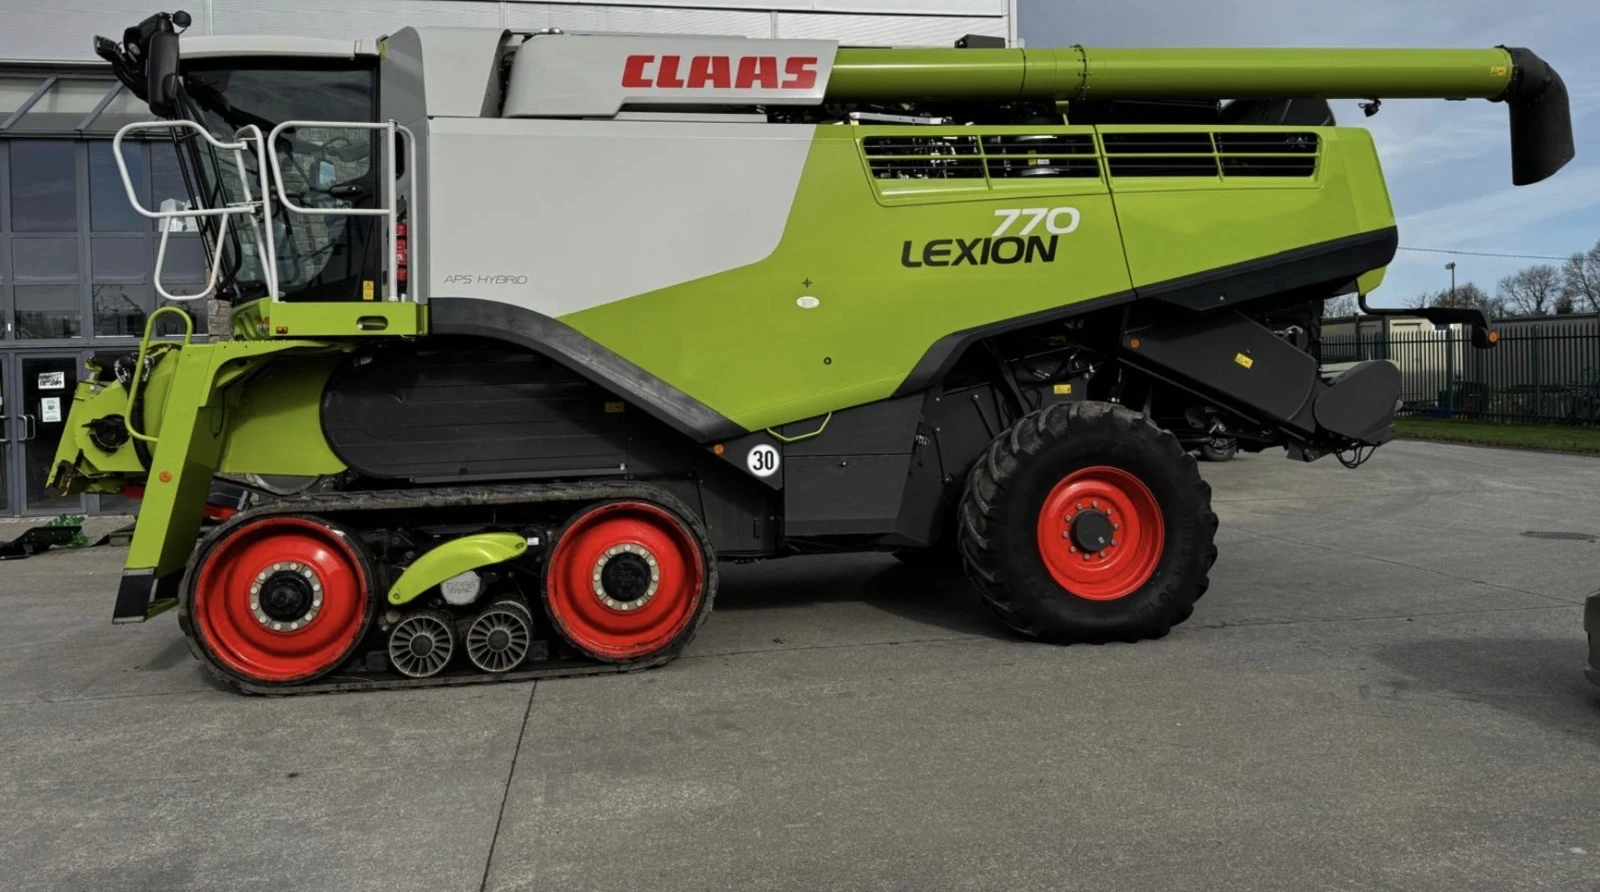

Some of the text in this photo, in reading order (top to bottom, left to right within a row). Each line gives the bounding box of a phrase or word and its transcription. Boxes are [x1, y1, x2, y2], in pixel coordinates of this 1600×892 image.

[621, 55, 818, 89] CLAAS
[991, 206, 1081, 237] 770
[901, 235, 1059, 268] LEXION
[443, 274, 529, 285] APS HYBRID
[753, 450, 774, 470] 30
